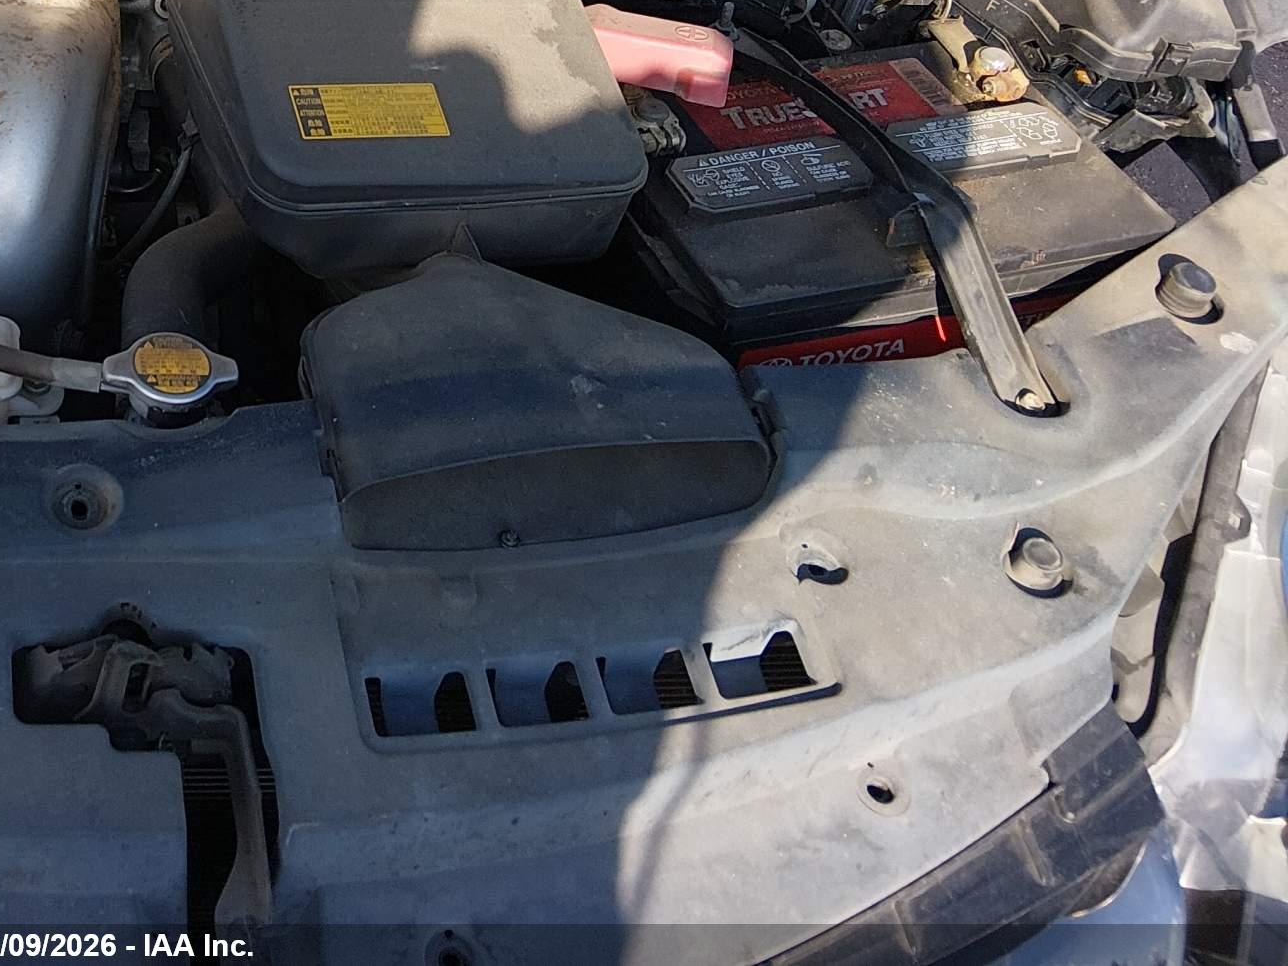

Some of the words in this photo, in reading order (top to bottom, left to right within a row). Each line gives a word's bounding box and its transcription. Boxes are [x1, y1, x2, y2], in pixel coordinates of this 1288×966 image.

[709, 150, 759, 166] DANGER
[769, 141, 815, 157] POISON
[799, 338, 905, 366] TOYOTA
